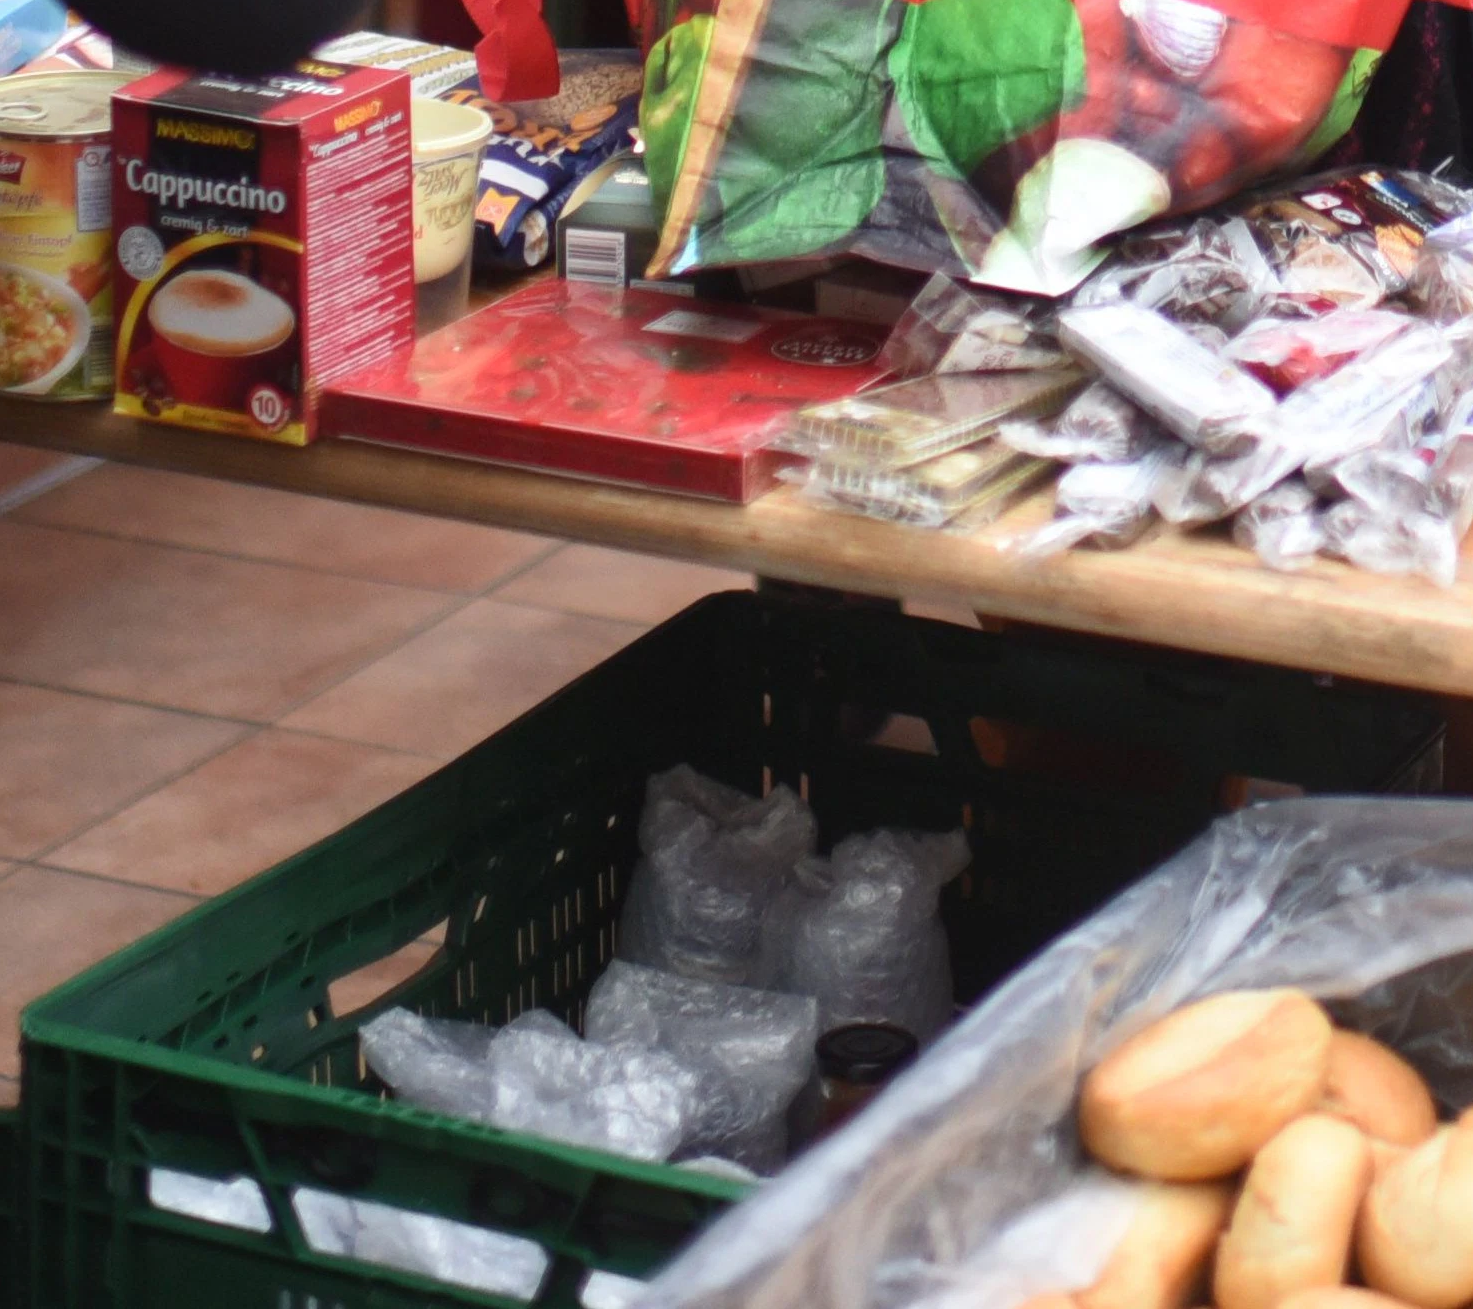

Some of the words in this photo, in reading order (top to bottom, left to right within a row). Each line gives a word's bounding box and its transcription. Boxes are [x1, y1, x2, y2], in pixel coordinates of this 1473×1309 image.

[125, 157, 287, 214] Cappuccino
[161, 214, 204, 234] cremig
[206, 218, 221, 233] &
[223, 222, 249, 238] zart
[254, 395, 277, 419] 10
